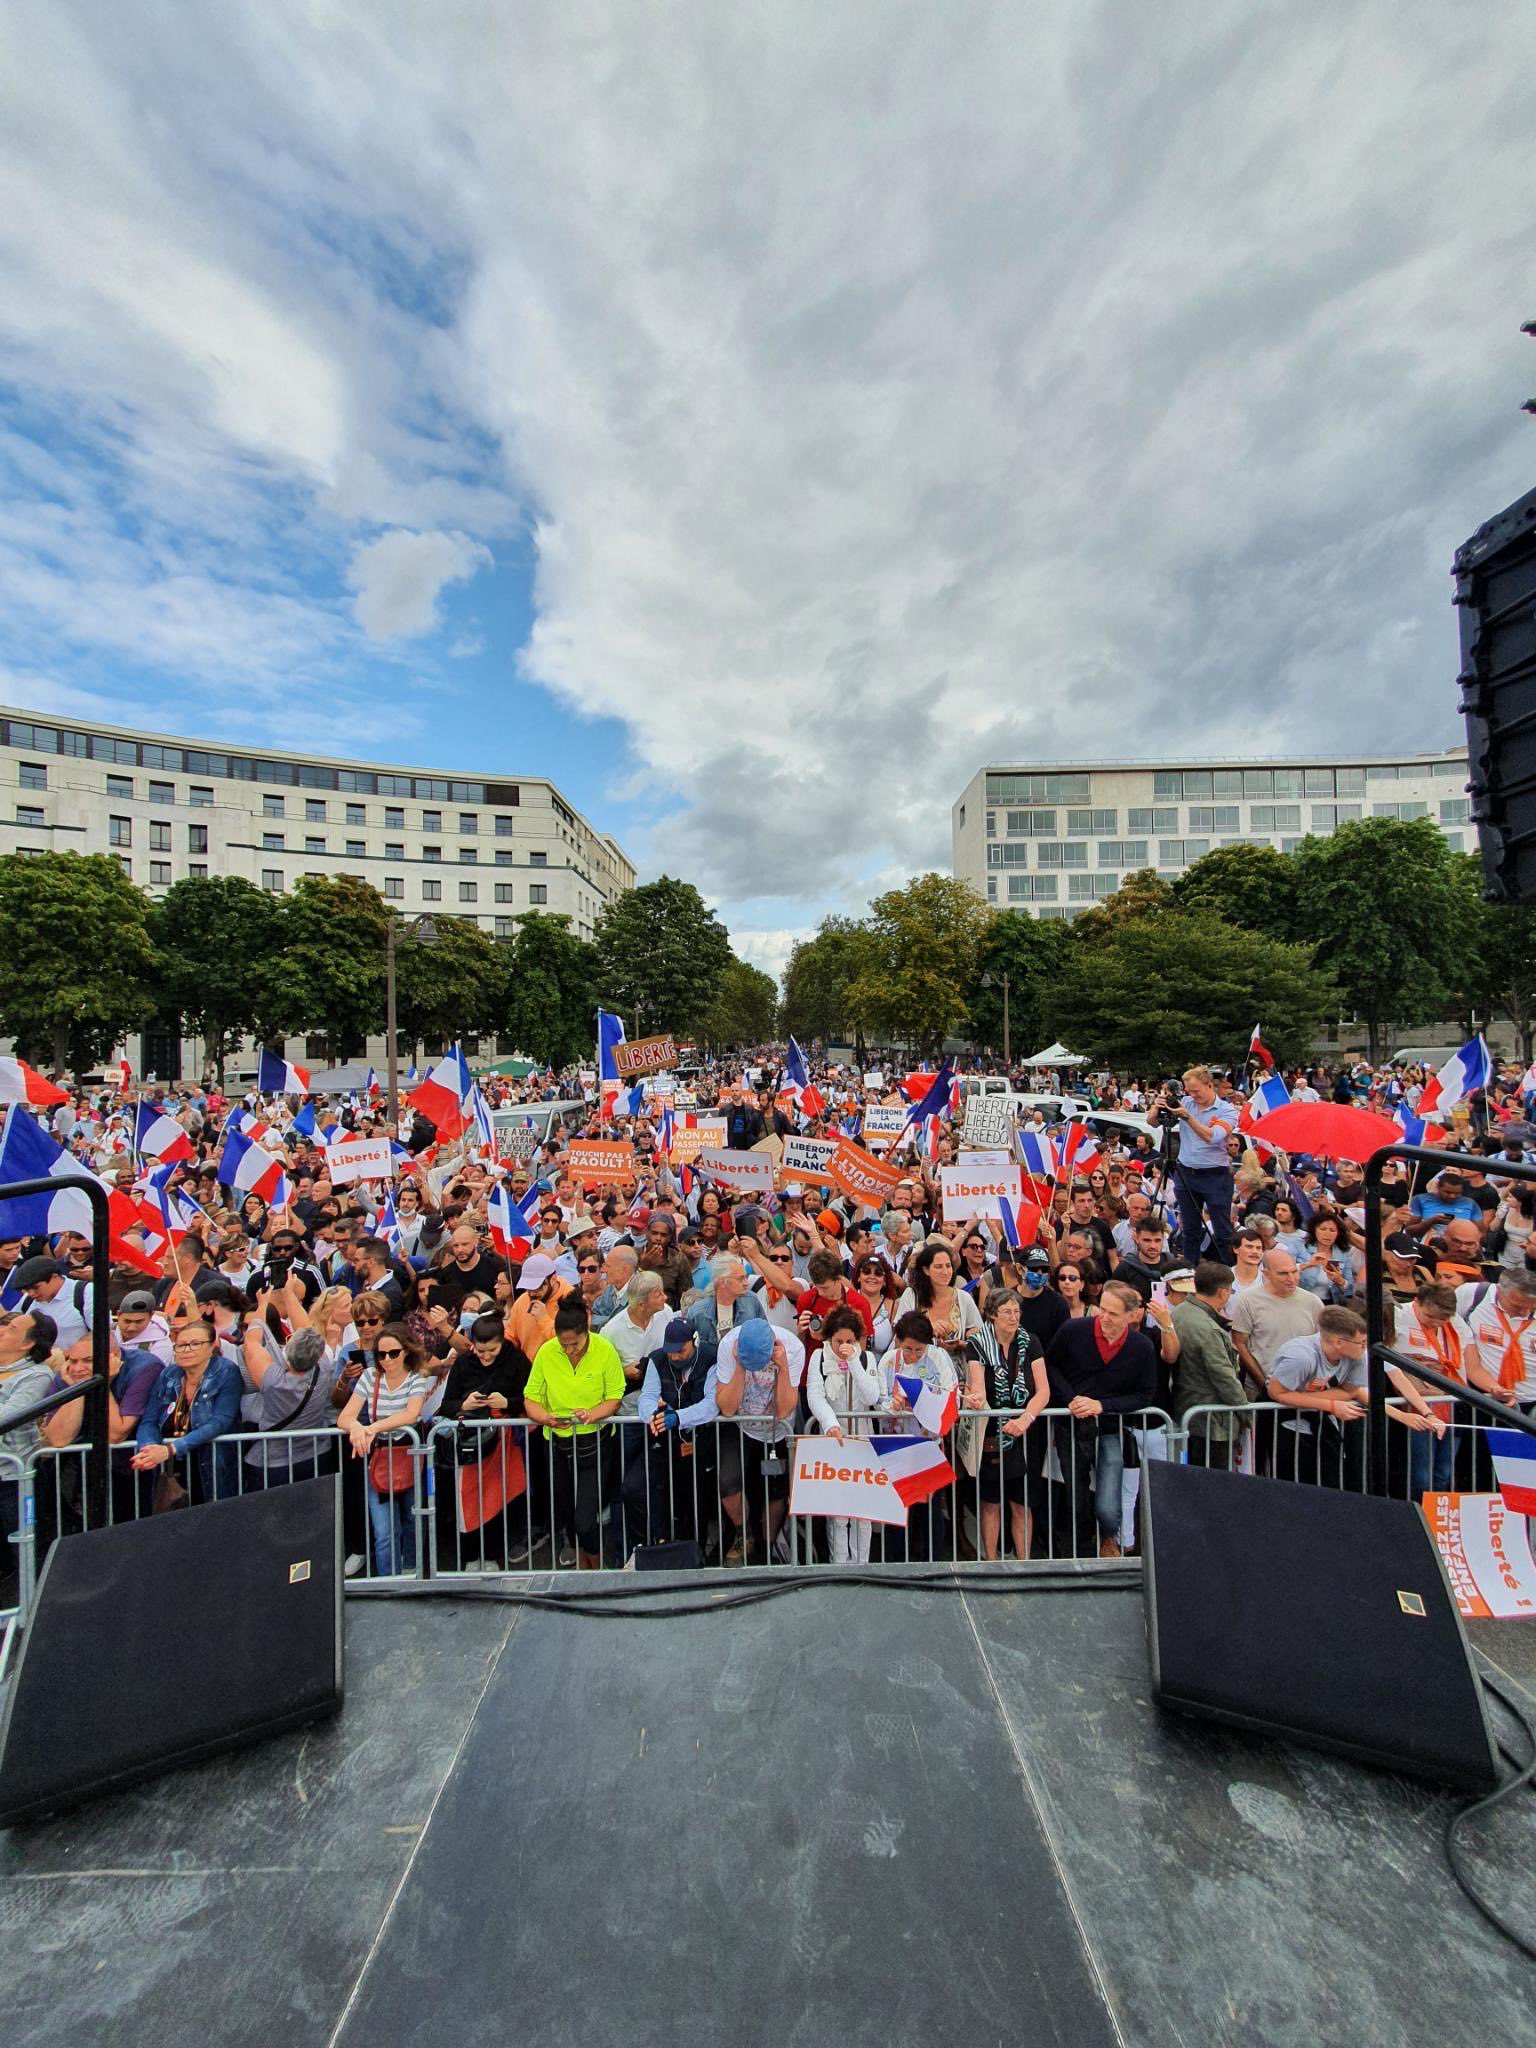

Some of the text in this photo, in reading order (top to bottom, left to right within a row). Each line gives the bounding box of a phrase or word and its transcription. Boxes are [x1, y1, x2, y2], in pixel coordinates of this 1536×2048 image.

[676, 1131, 717, 1140] NON AU
[673, 1140, 718, 1149] PASSEPORT
[790, 1141, 836, 1155] LIBÉRON
[332, 1149, 388, 1167] Liberté !
[570, 1156, 632, 1169] RAOULT !
[571, 1150, 632, 1160] TOUCHE PAS À
[805, 1151, 819, 1160] LA
[706, 1159, 769, 1174] Liberté !
[786, 1157, 827, 1172] FRANC
[839, 1158, 895, 1193] RAOULT
[946, 1182, 1017, 1197] Liberté !
[800, 1461, 889, 1486] Liberté
[1448, 1508, 1479, 1597] ENFANTS
[1488, 1500, 1521, 1590] Liberté
[1436, 1495, 1474, 1614] LAISSEZ LES
